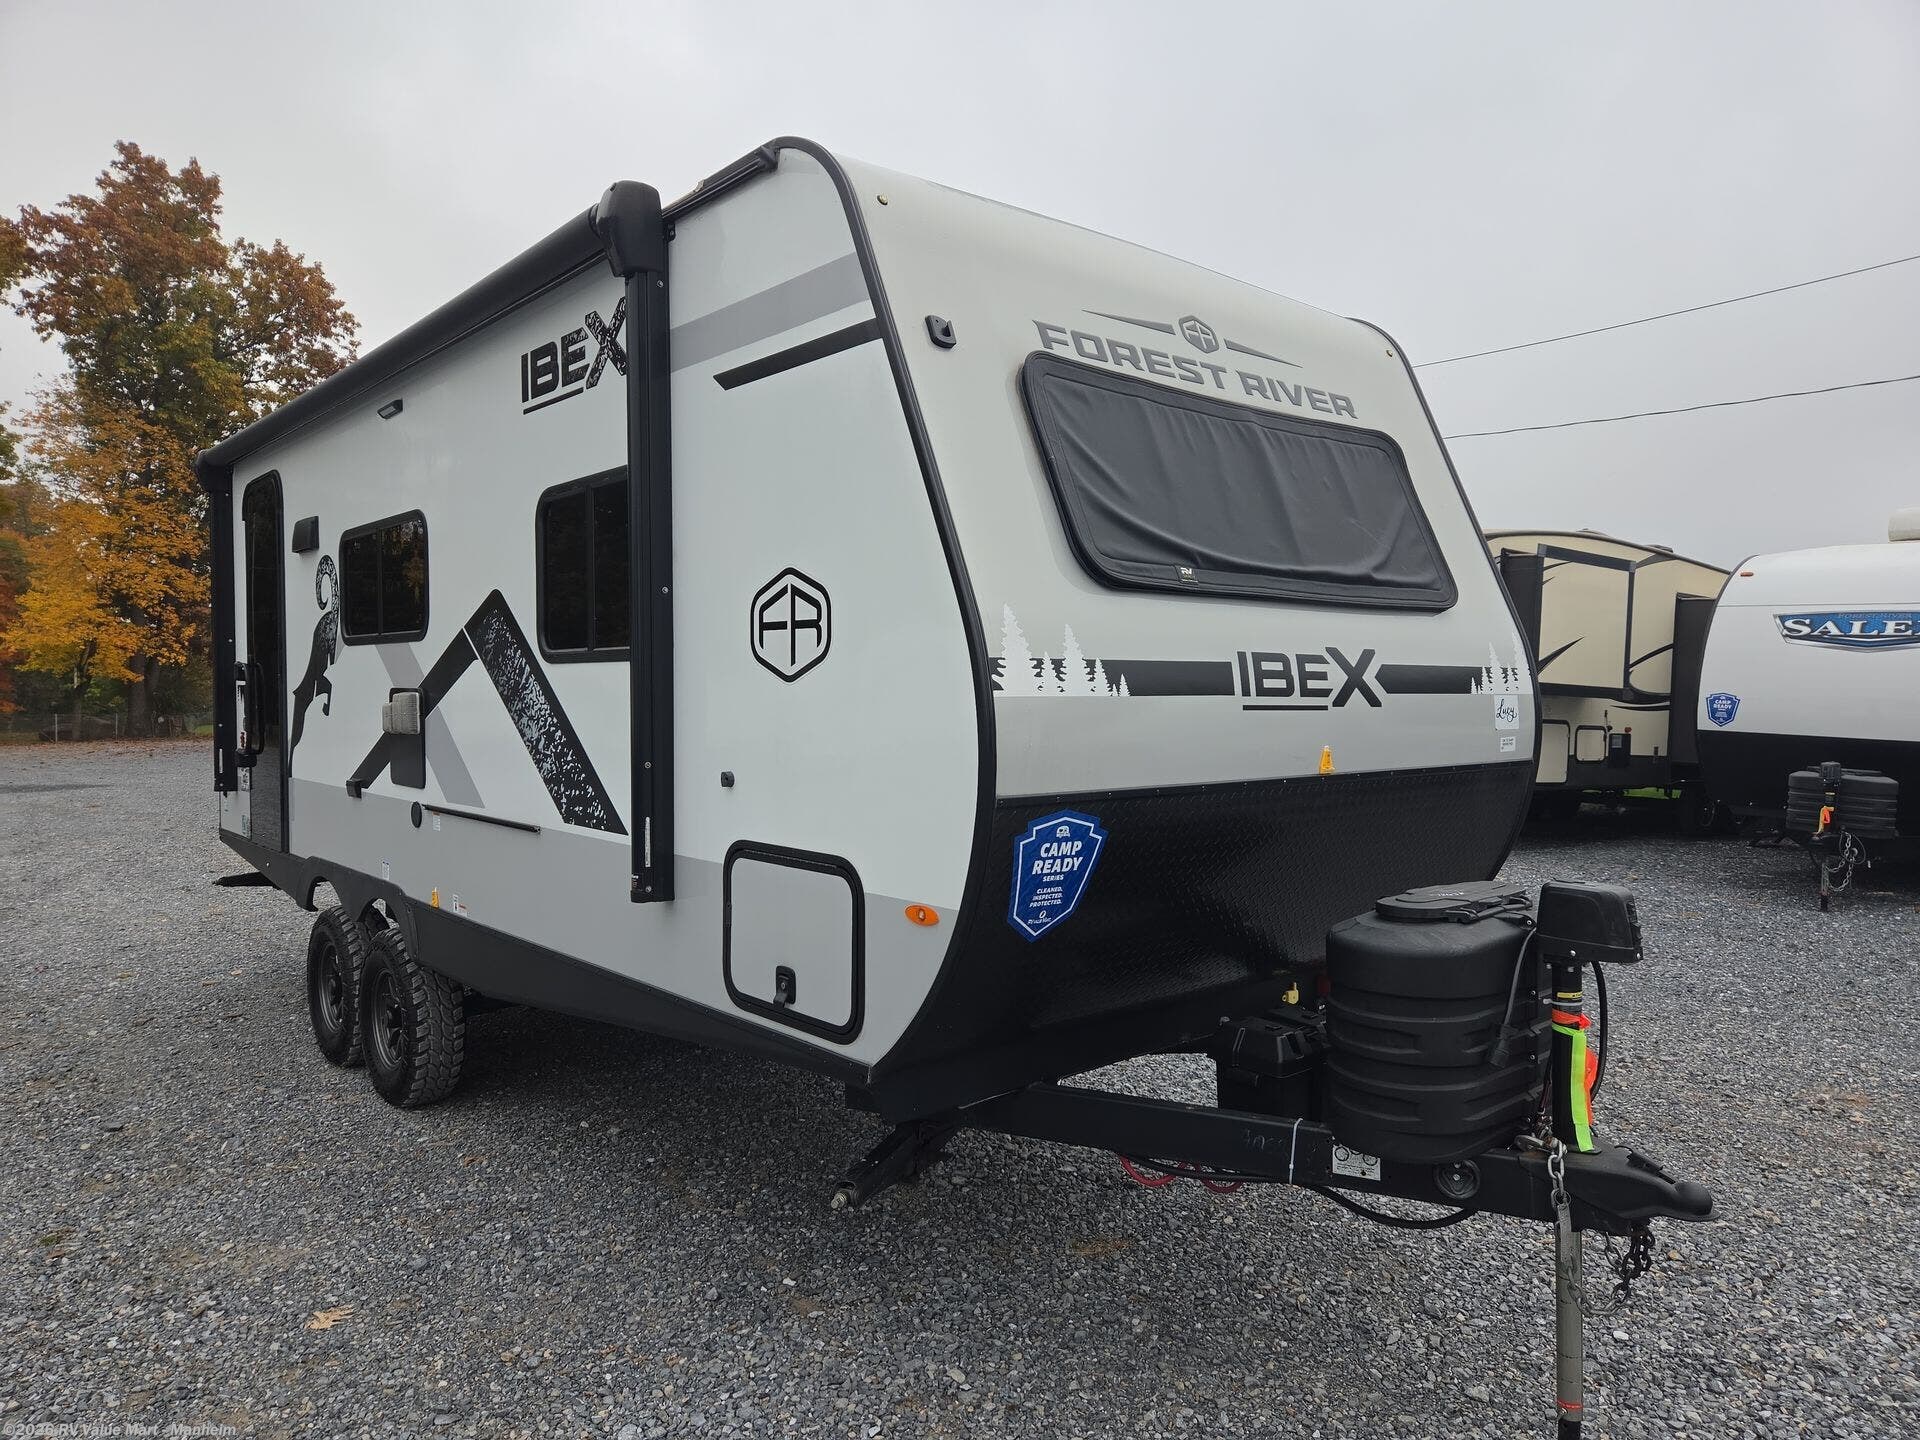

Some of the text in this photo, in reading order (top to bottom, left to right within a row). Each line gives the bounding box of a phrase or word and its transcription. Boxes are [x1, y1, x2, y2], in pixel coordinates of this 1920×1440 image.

[521, 296, 628, 404] IBEX
[1032, 319, 1358, 419] FOREST RIVER
[1783, 619, 1920, 636] SALE
[1236, 646, 1382, 708] IBEX
[1040, 840, 1083, 858] CAMP
[1032, 857, 1084, 875] READY
[1042, 874, 1064, 882] SERIES
[1032, 893, 1063, 901] INSPECTED.
[1036, 886, 1063, 894] CLEANED.
[1029, 899, 1062, 908] PROTECTED.
